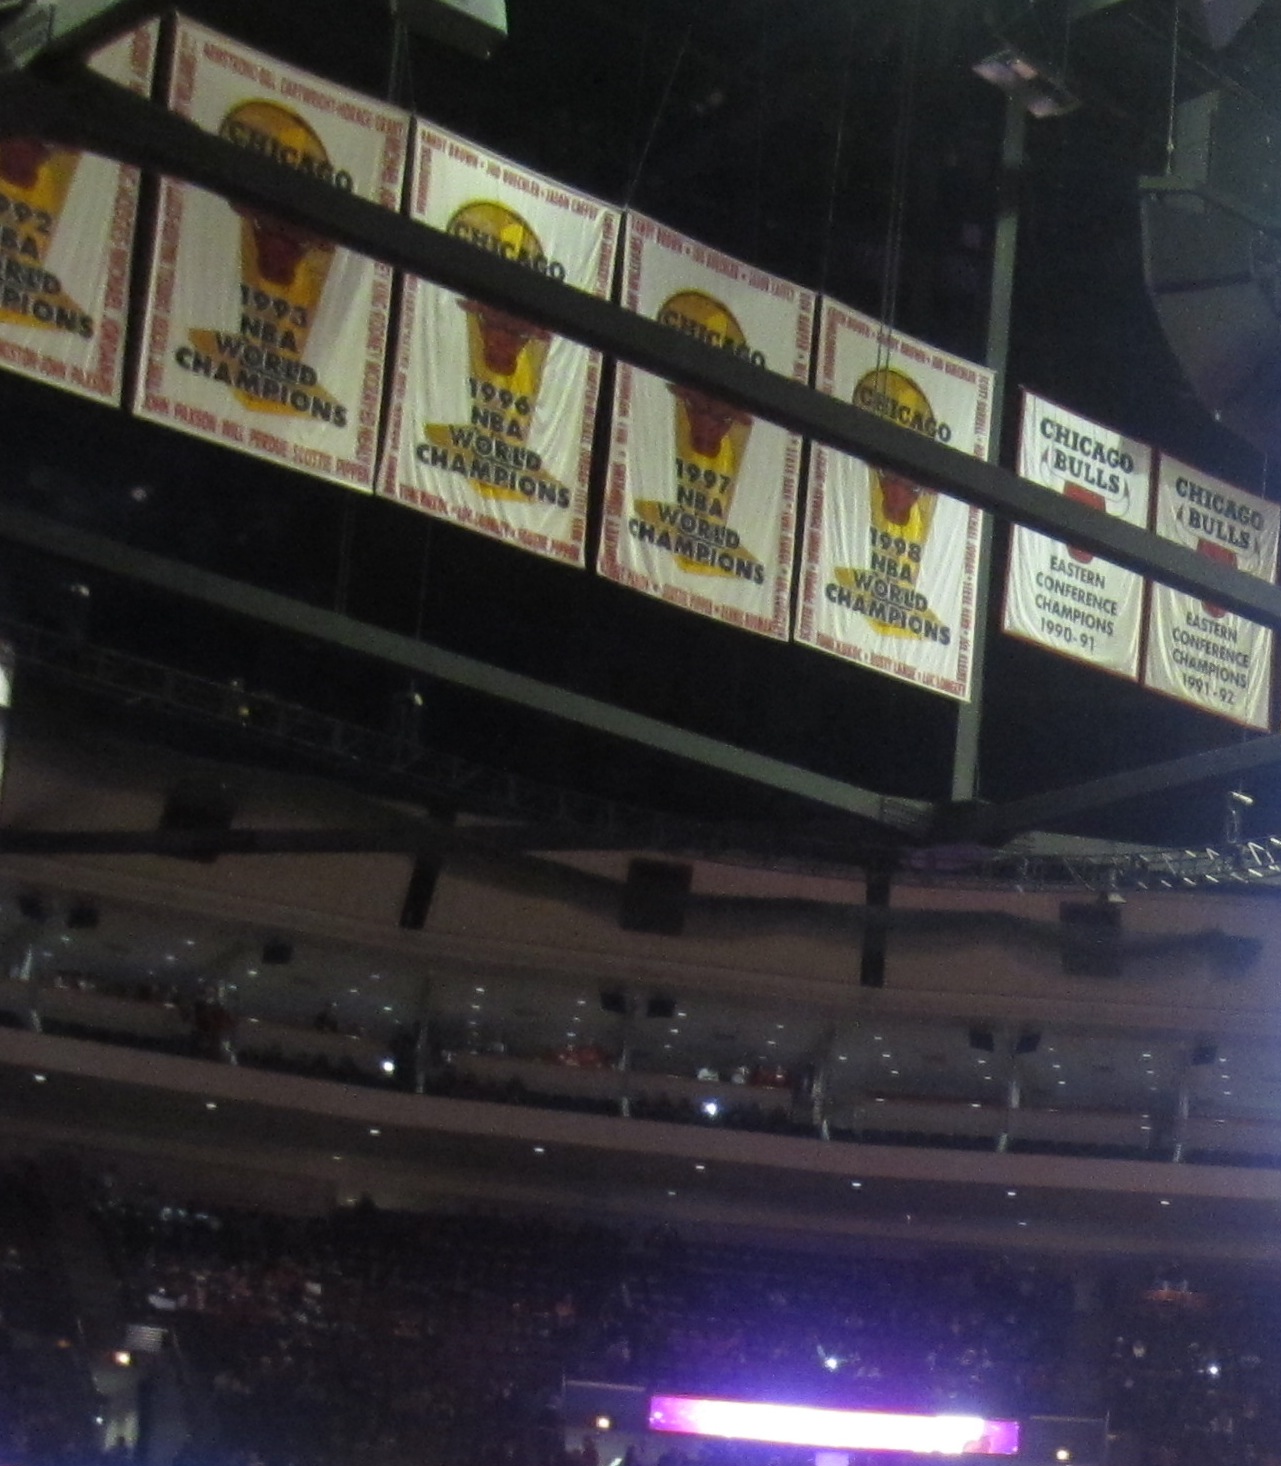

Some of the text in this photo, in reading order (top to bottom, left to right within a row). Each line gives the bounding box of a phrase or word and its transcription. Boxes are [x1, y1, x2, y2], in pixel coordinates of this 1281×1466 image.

[240, 313, 297, 352] NBA
[215, 330, 318, 387] WORLD
[174, 346, 348, 428] CHAMPIONS
[469, 376, 532, 415] 1996
[471, 404, 524, 440] NBA
[450, 424, 543, 470] WORLD
[1040, 417, 1134, 475] CHICAGO
[416, 443, 571, 509] CHAMPIONS
[674, 457, 732, 495] 1997
[1053, 449, 1121, 495] BULLS
[675, 485, 726, 518] NBA
[1175, 476, 1265, 532] CHICAGO
[656, 502, 741, 550] WORLD
[868, 524, 922, 564] 1998
[1188, 508, 1251, 550] BULLS
[628, 518, 766, 586] CHAMPIONS
[870, 551, 913, 585] NBA
[1050, 556, 1106, 590] EASTERN
[853, 570, 930, 612] WORLD
[1035, 571, 1118, 617] CONFERENCE
[825, 583, 951, 646] CHAMPIONS
[1035, 593, 1114, 637] CHAMPIONS
[1186, 611, 1238, 643] EASTERN
[1172, 627, 1249, 669] CONFERENCE
[1172, 647, 1248, 690] CHAMPIONS
